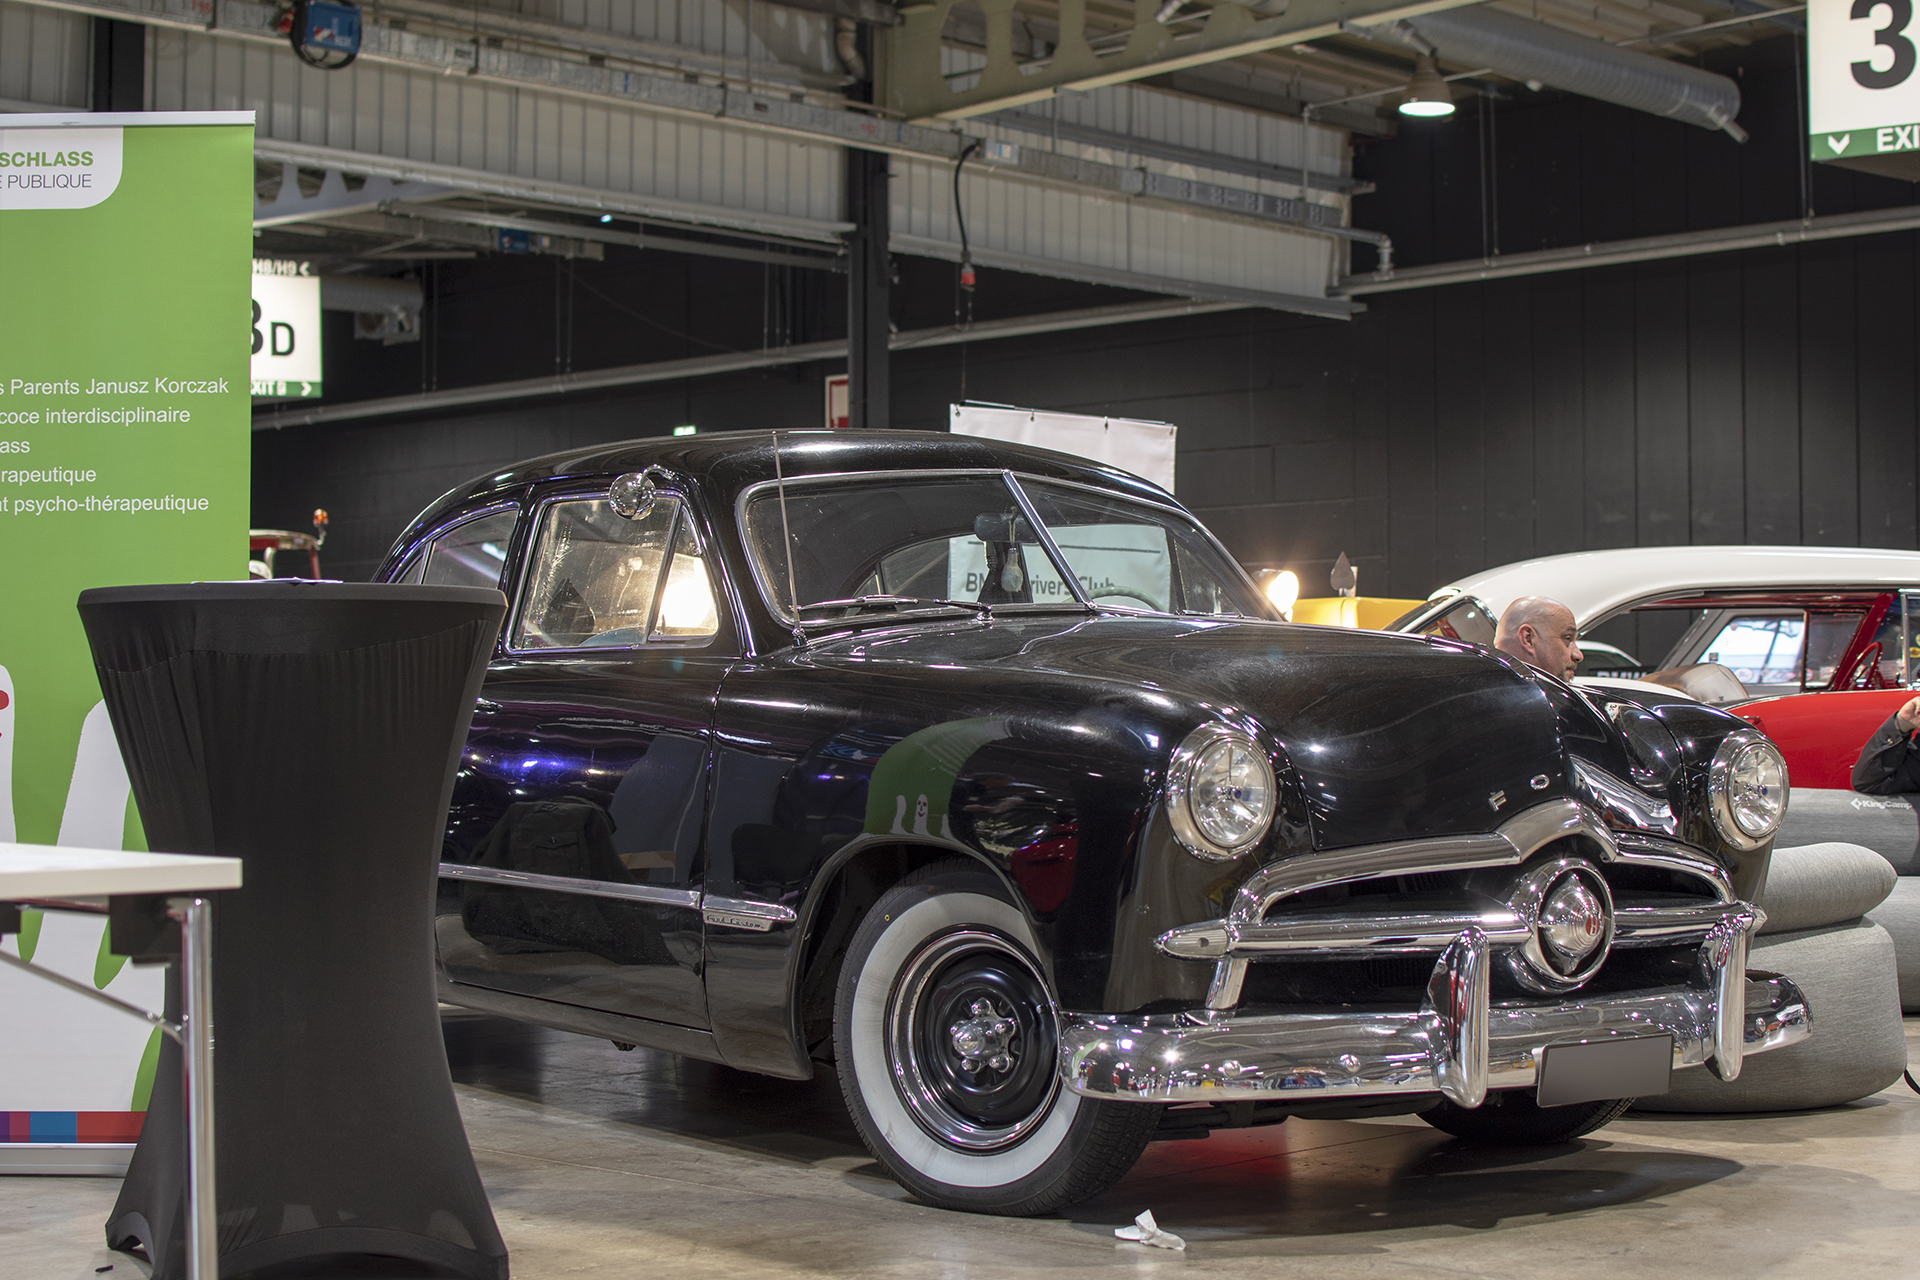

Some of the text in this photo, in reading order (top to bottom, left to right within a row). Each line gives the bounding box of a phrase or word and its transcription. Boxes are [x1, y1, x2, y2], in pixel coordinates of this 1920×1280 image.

[1849, 0, 1917, 90] 3
[8, 173, 92, 189] PUBLIQUE
[10, 378, 80, 395] Parents
[85, 378, 149, 395] Janusz
[155, 377, 229, 394] Korczak
[251, 381, 275, 395] XIT
[46, 407, 191, 427] interdisciplinaire
[14, 494, 209, 516] psycho-thérapeutique
